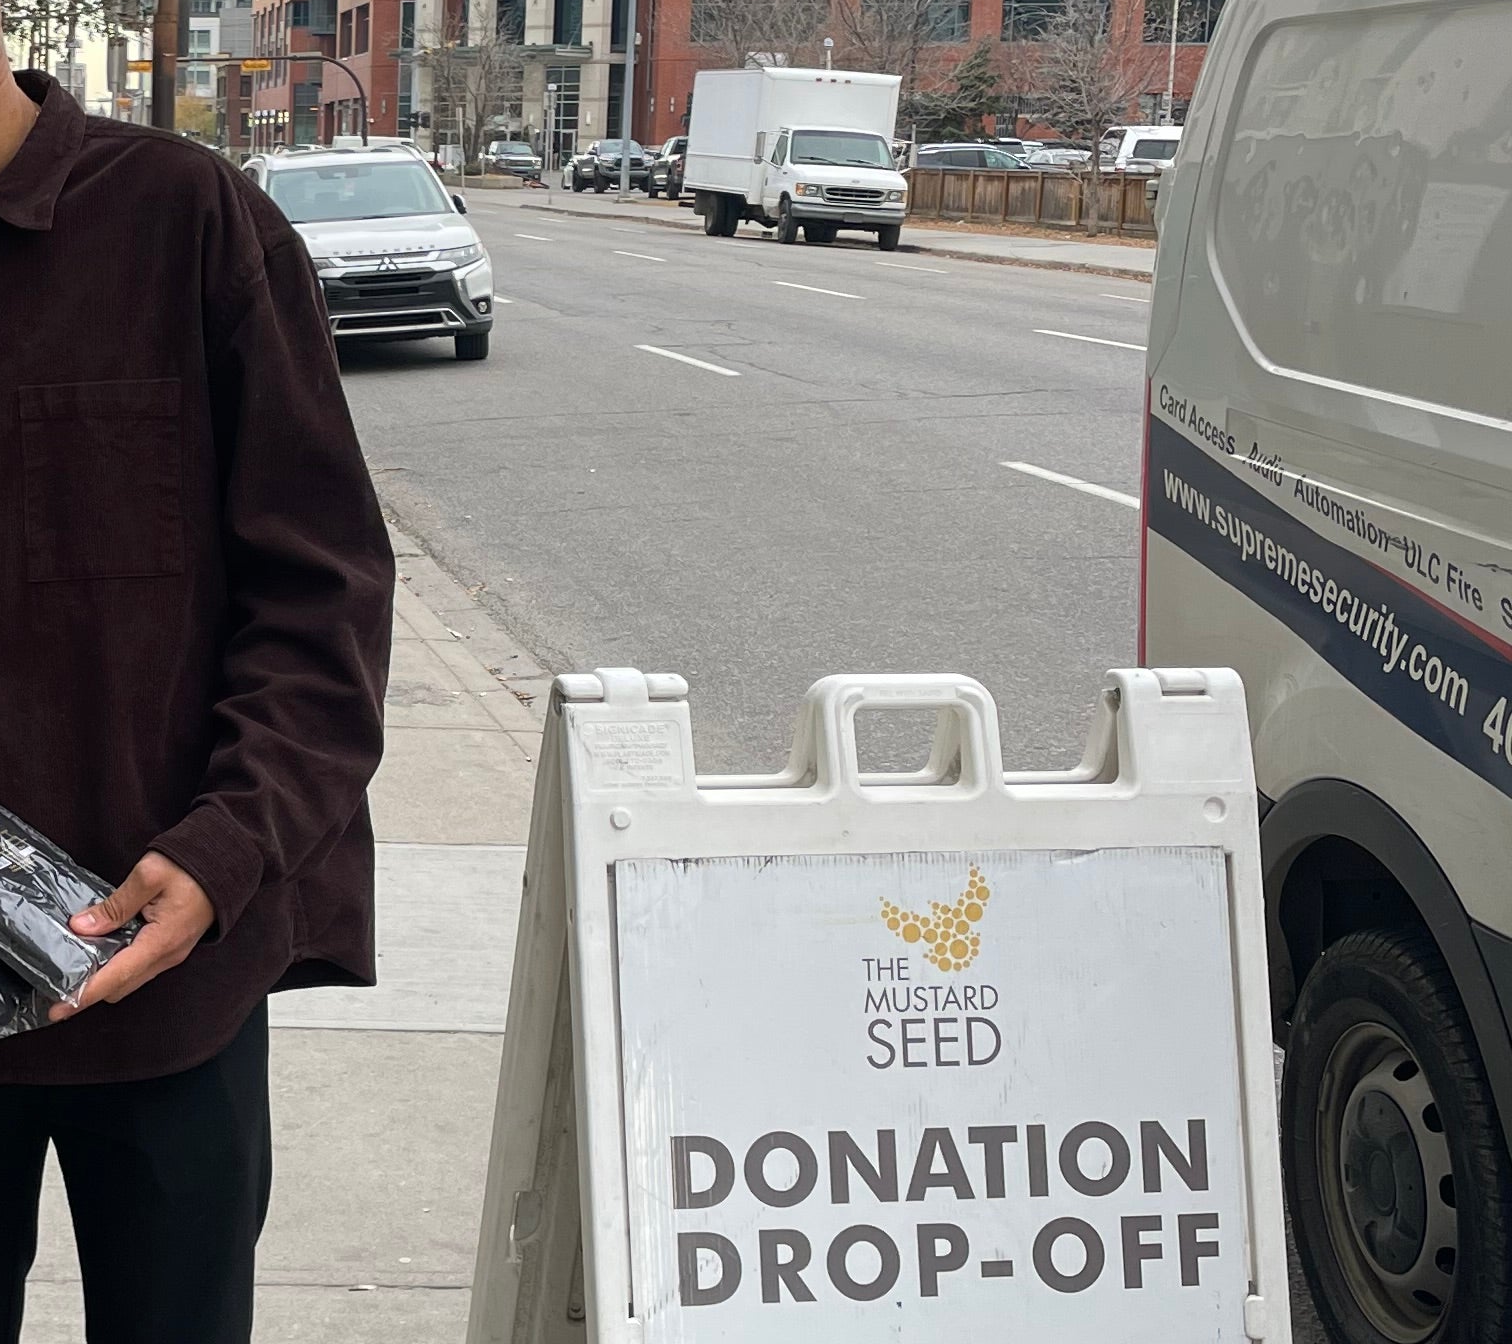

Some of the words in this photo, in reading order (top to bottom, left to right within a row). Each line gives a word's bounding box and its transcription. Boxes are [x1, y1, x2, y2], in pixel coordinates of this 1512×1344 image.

[1159, 384, 1187, 424] Card
[1188, 404, 1235, 455] Access
[1242, 441, 1286, 487] Audio
[1294, 473, 1390, 553] Automation
[1402, 535, 1440, 586] ULC
[1446, 562, 1483, 612] Fire
[1163, 467, 1469, 717] www.supremesecurity.com
[862, 957, 910, 982] THE
[863, 984, 999, 1014] MUSTARD
[866, 1016, 1002, 1070] SEED
[670, 1118, 1210, 1210] DONATION
[676, 1212, 1220, 1307] DROP-OFF
